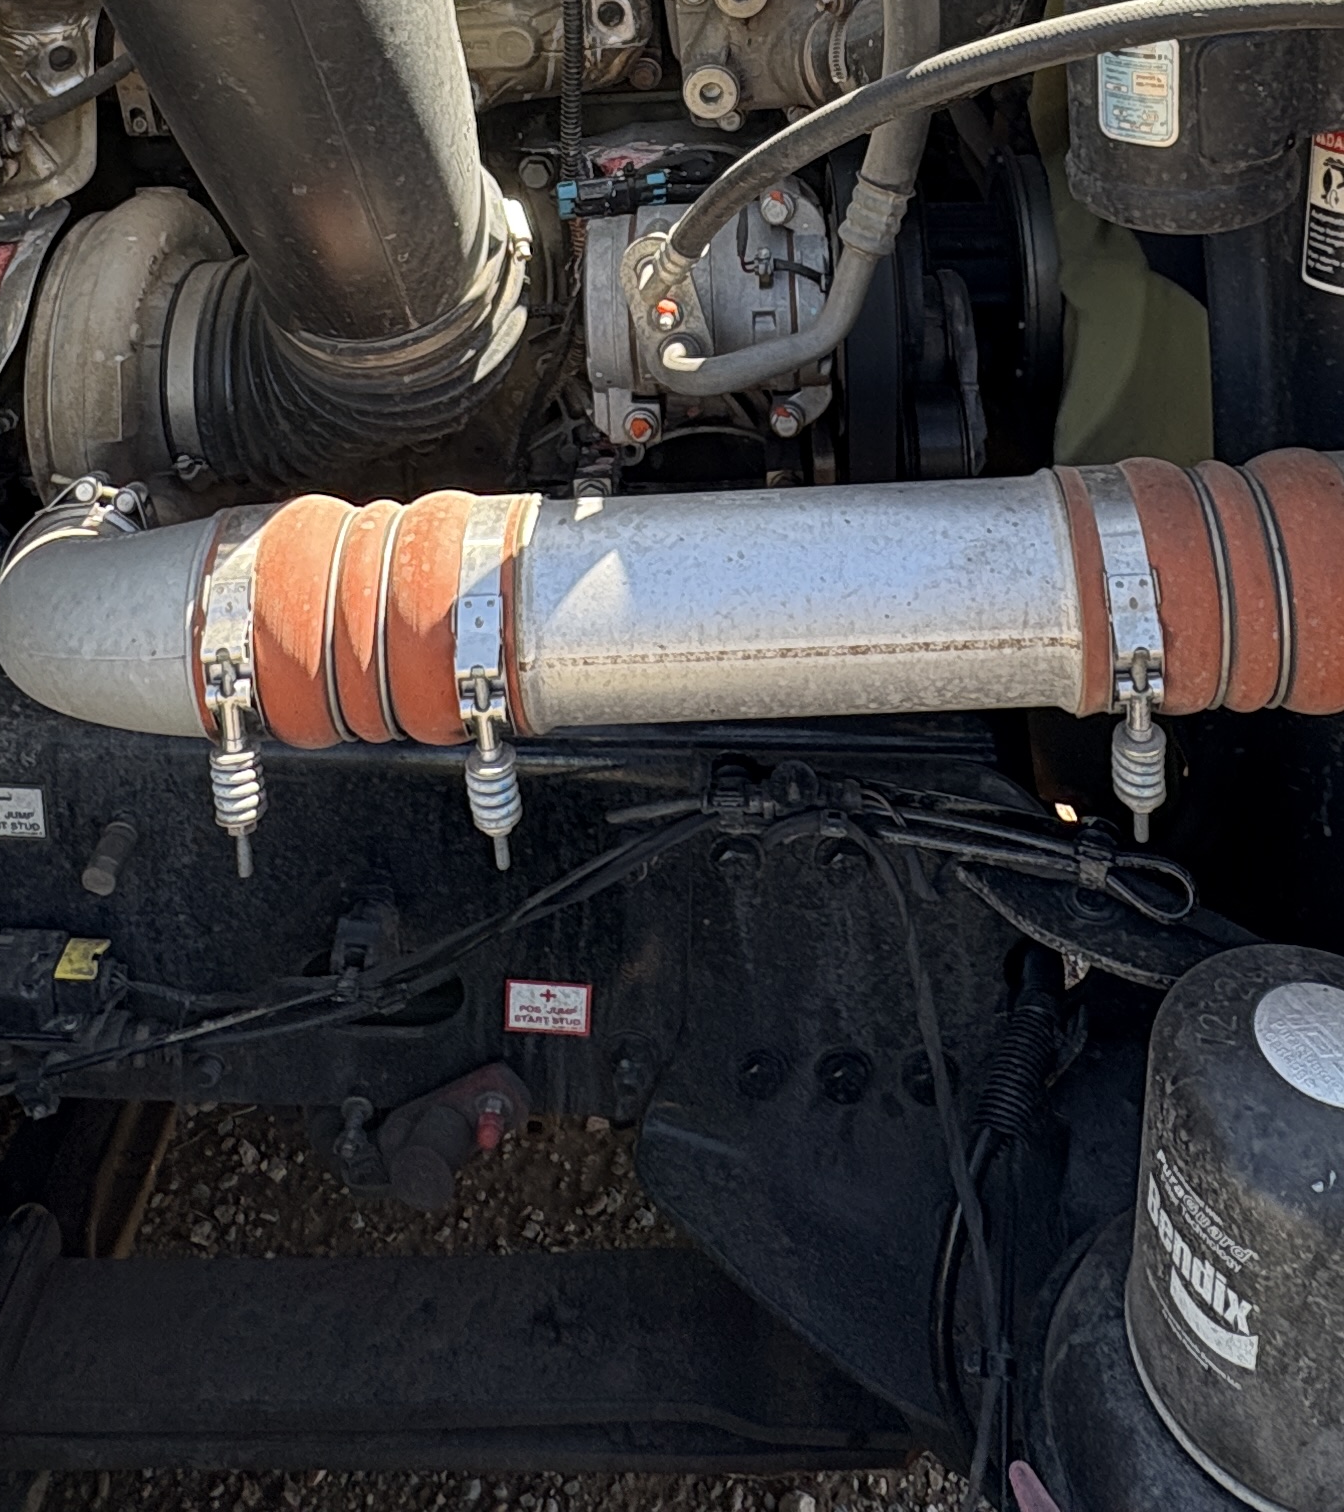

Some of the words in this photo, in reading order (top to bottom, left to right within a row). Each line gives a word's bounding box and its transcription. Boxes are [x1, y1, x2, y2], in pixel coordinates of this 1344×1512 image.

[4, 810, 35, 820] JUMP
[11, 821, 41, 831] STUD
[519, 1004, 542, 1014] POS
[545, 1005, 578, 1015] JUMP
[514, 1014, 549, 1024] START
[552, 1017, 581, 1026] STUD
[1181, 1202, 1242, 1273] Technology
[1147, 1171, 1253, 1336] Bendix
